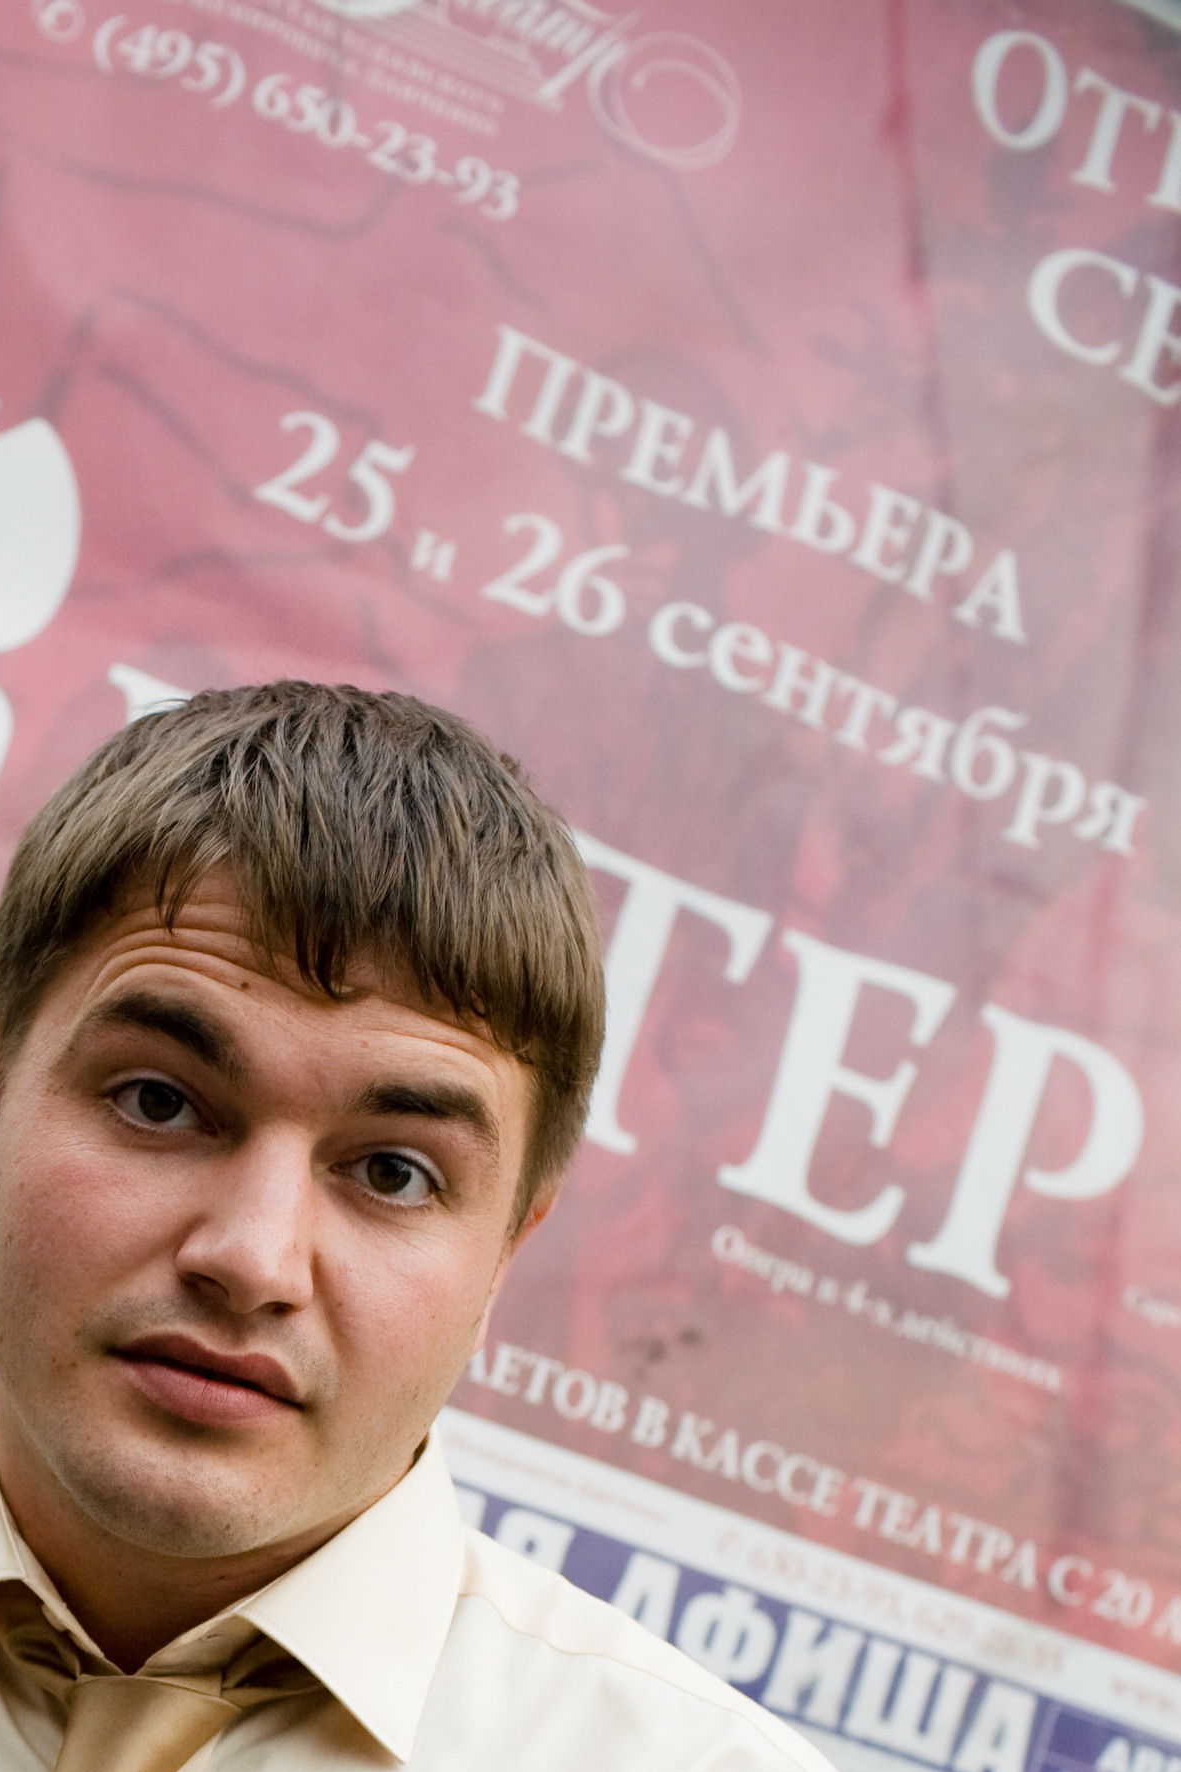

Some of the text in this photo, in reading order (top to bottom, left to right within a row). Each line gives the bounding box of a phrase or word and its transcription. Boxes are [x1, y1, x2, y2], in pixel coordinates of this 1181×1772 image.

[91, 12, 521, 222] (495) 650-23-93
[472, 323, 1029, 645] ПРЕМЬЕРА
[255, 408, 1153, 858] 25 и 26 сентября
[670, 1411, 846, 1518] КАССЕ
[850, 1477, 1039, 1593] ТЕАТРА
[1047, 1553, 1094, 1609] С
[1091, 1567, 1155, 1631] 20
